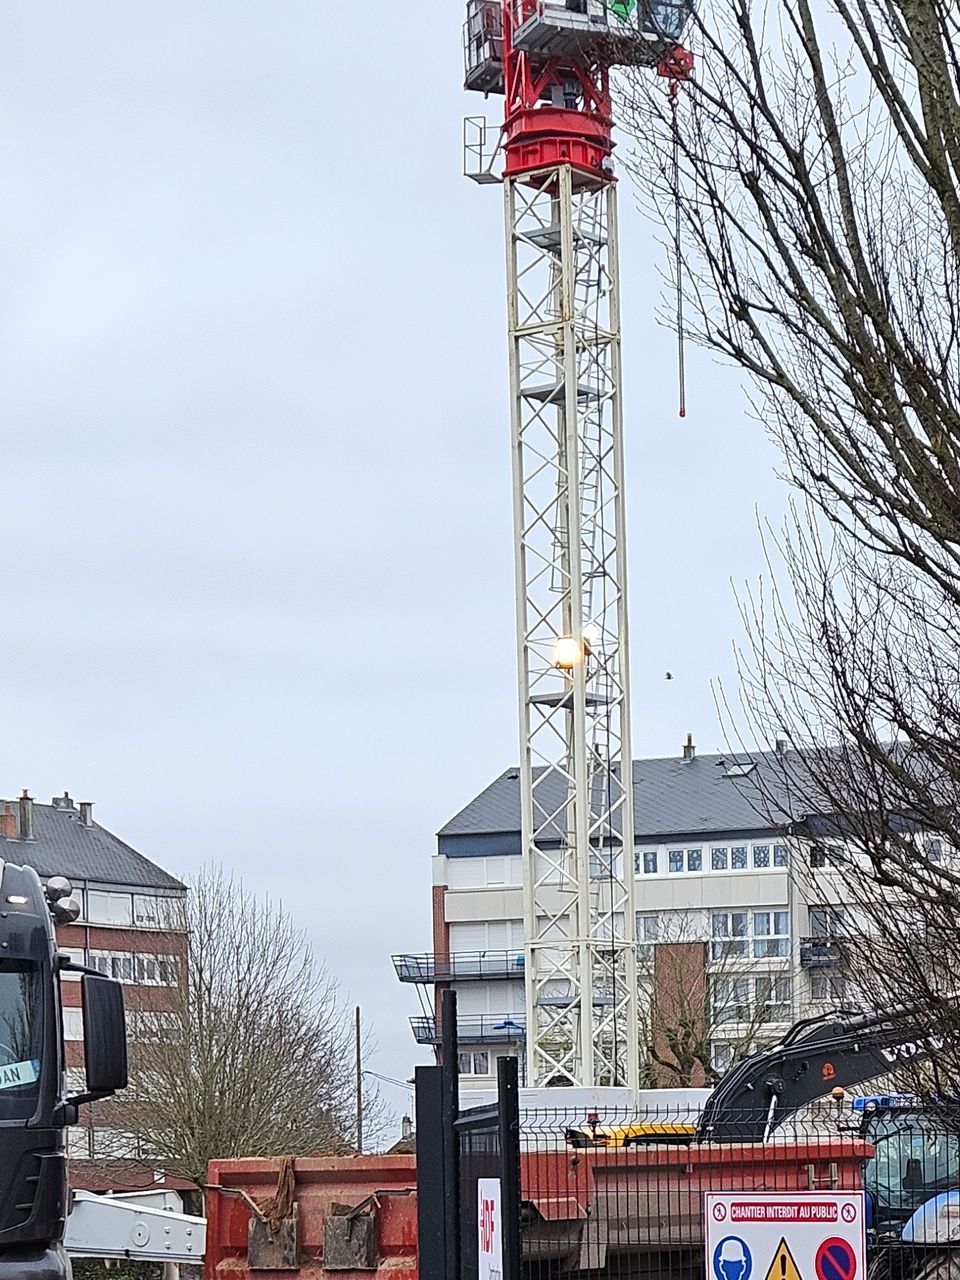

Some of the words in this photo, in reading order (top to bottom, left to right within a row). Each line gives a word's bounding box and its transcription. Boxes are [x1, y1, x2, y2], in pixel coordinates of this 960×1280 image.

[0, 1067, 21, 1085] AN
[732, 1205, 765, 1218] CHANTIER
[767, 1206, 798, 1218] INTERDIT
[800, 1206, 810, 1218] AU
[812, 1206, 837, 1218] PUBLIC
